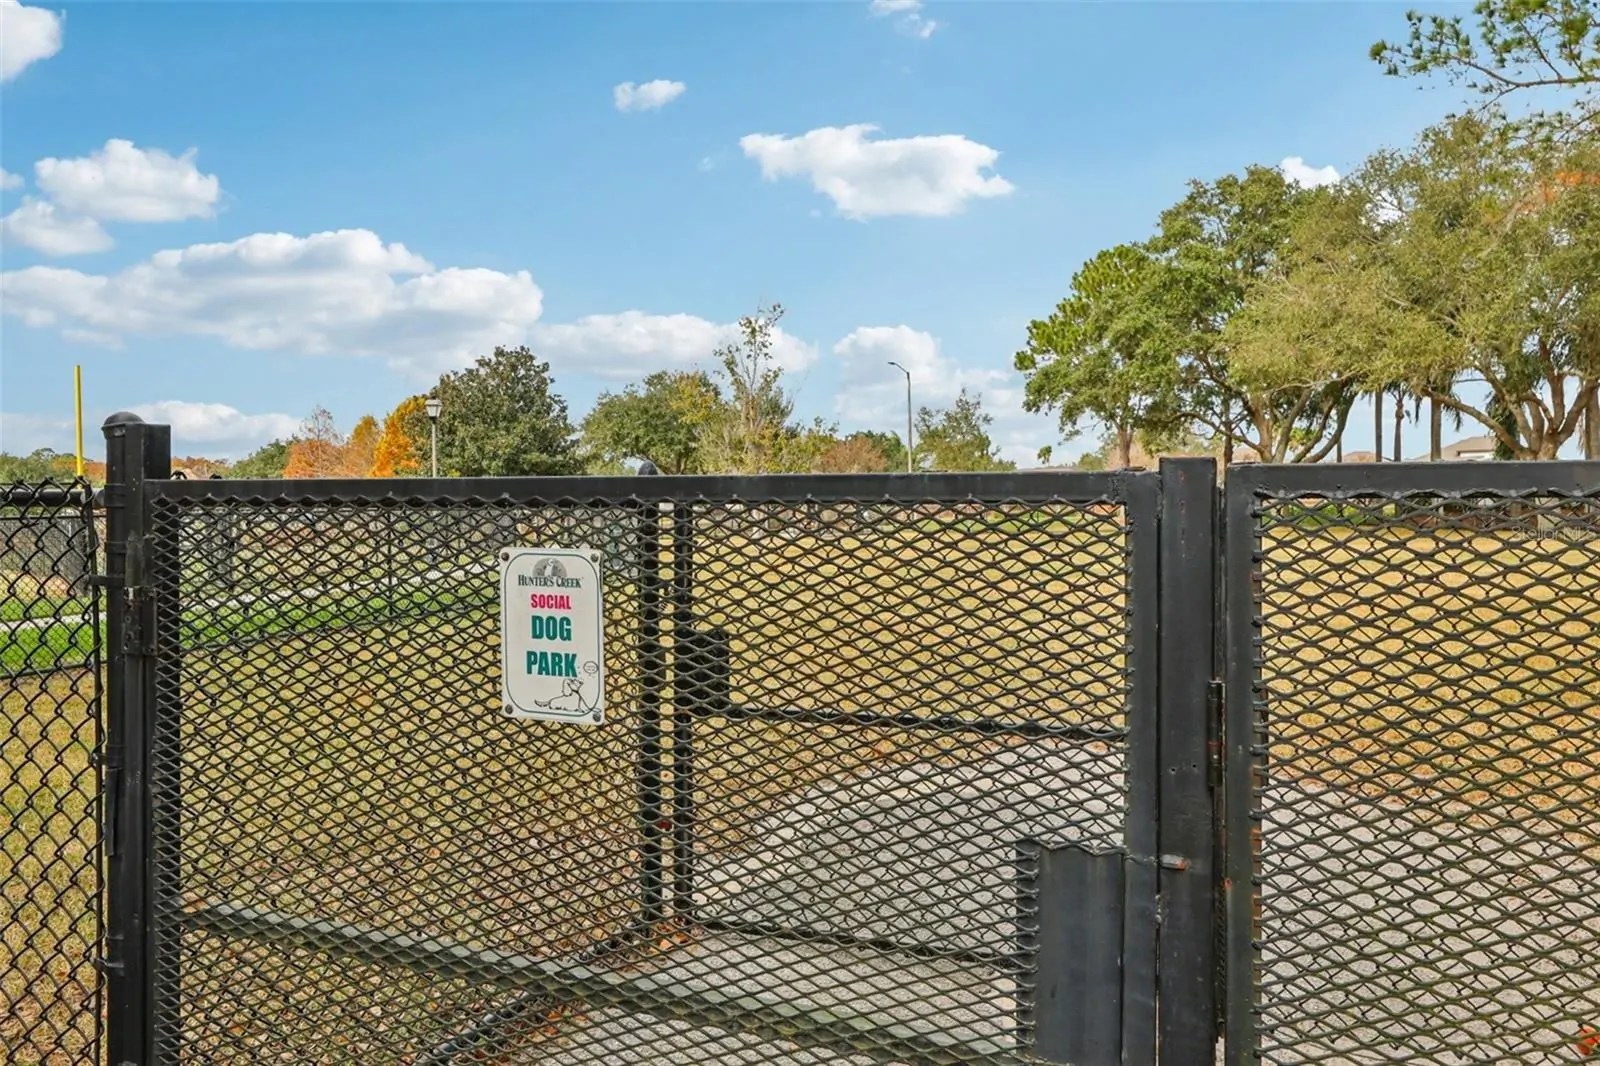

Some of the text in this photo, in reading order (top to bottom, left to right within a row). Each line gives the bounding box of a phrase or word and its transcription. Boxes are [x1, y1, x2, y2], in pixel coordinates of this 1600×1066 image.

[518, 574, 582, 588] HUNTER'S CREEK
[530, 593, 572, 610] SOCIAL
[531, 615, 572, 642] DOG
[526, 650, 578, 678] PARK
